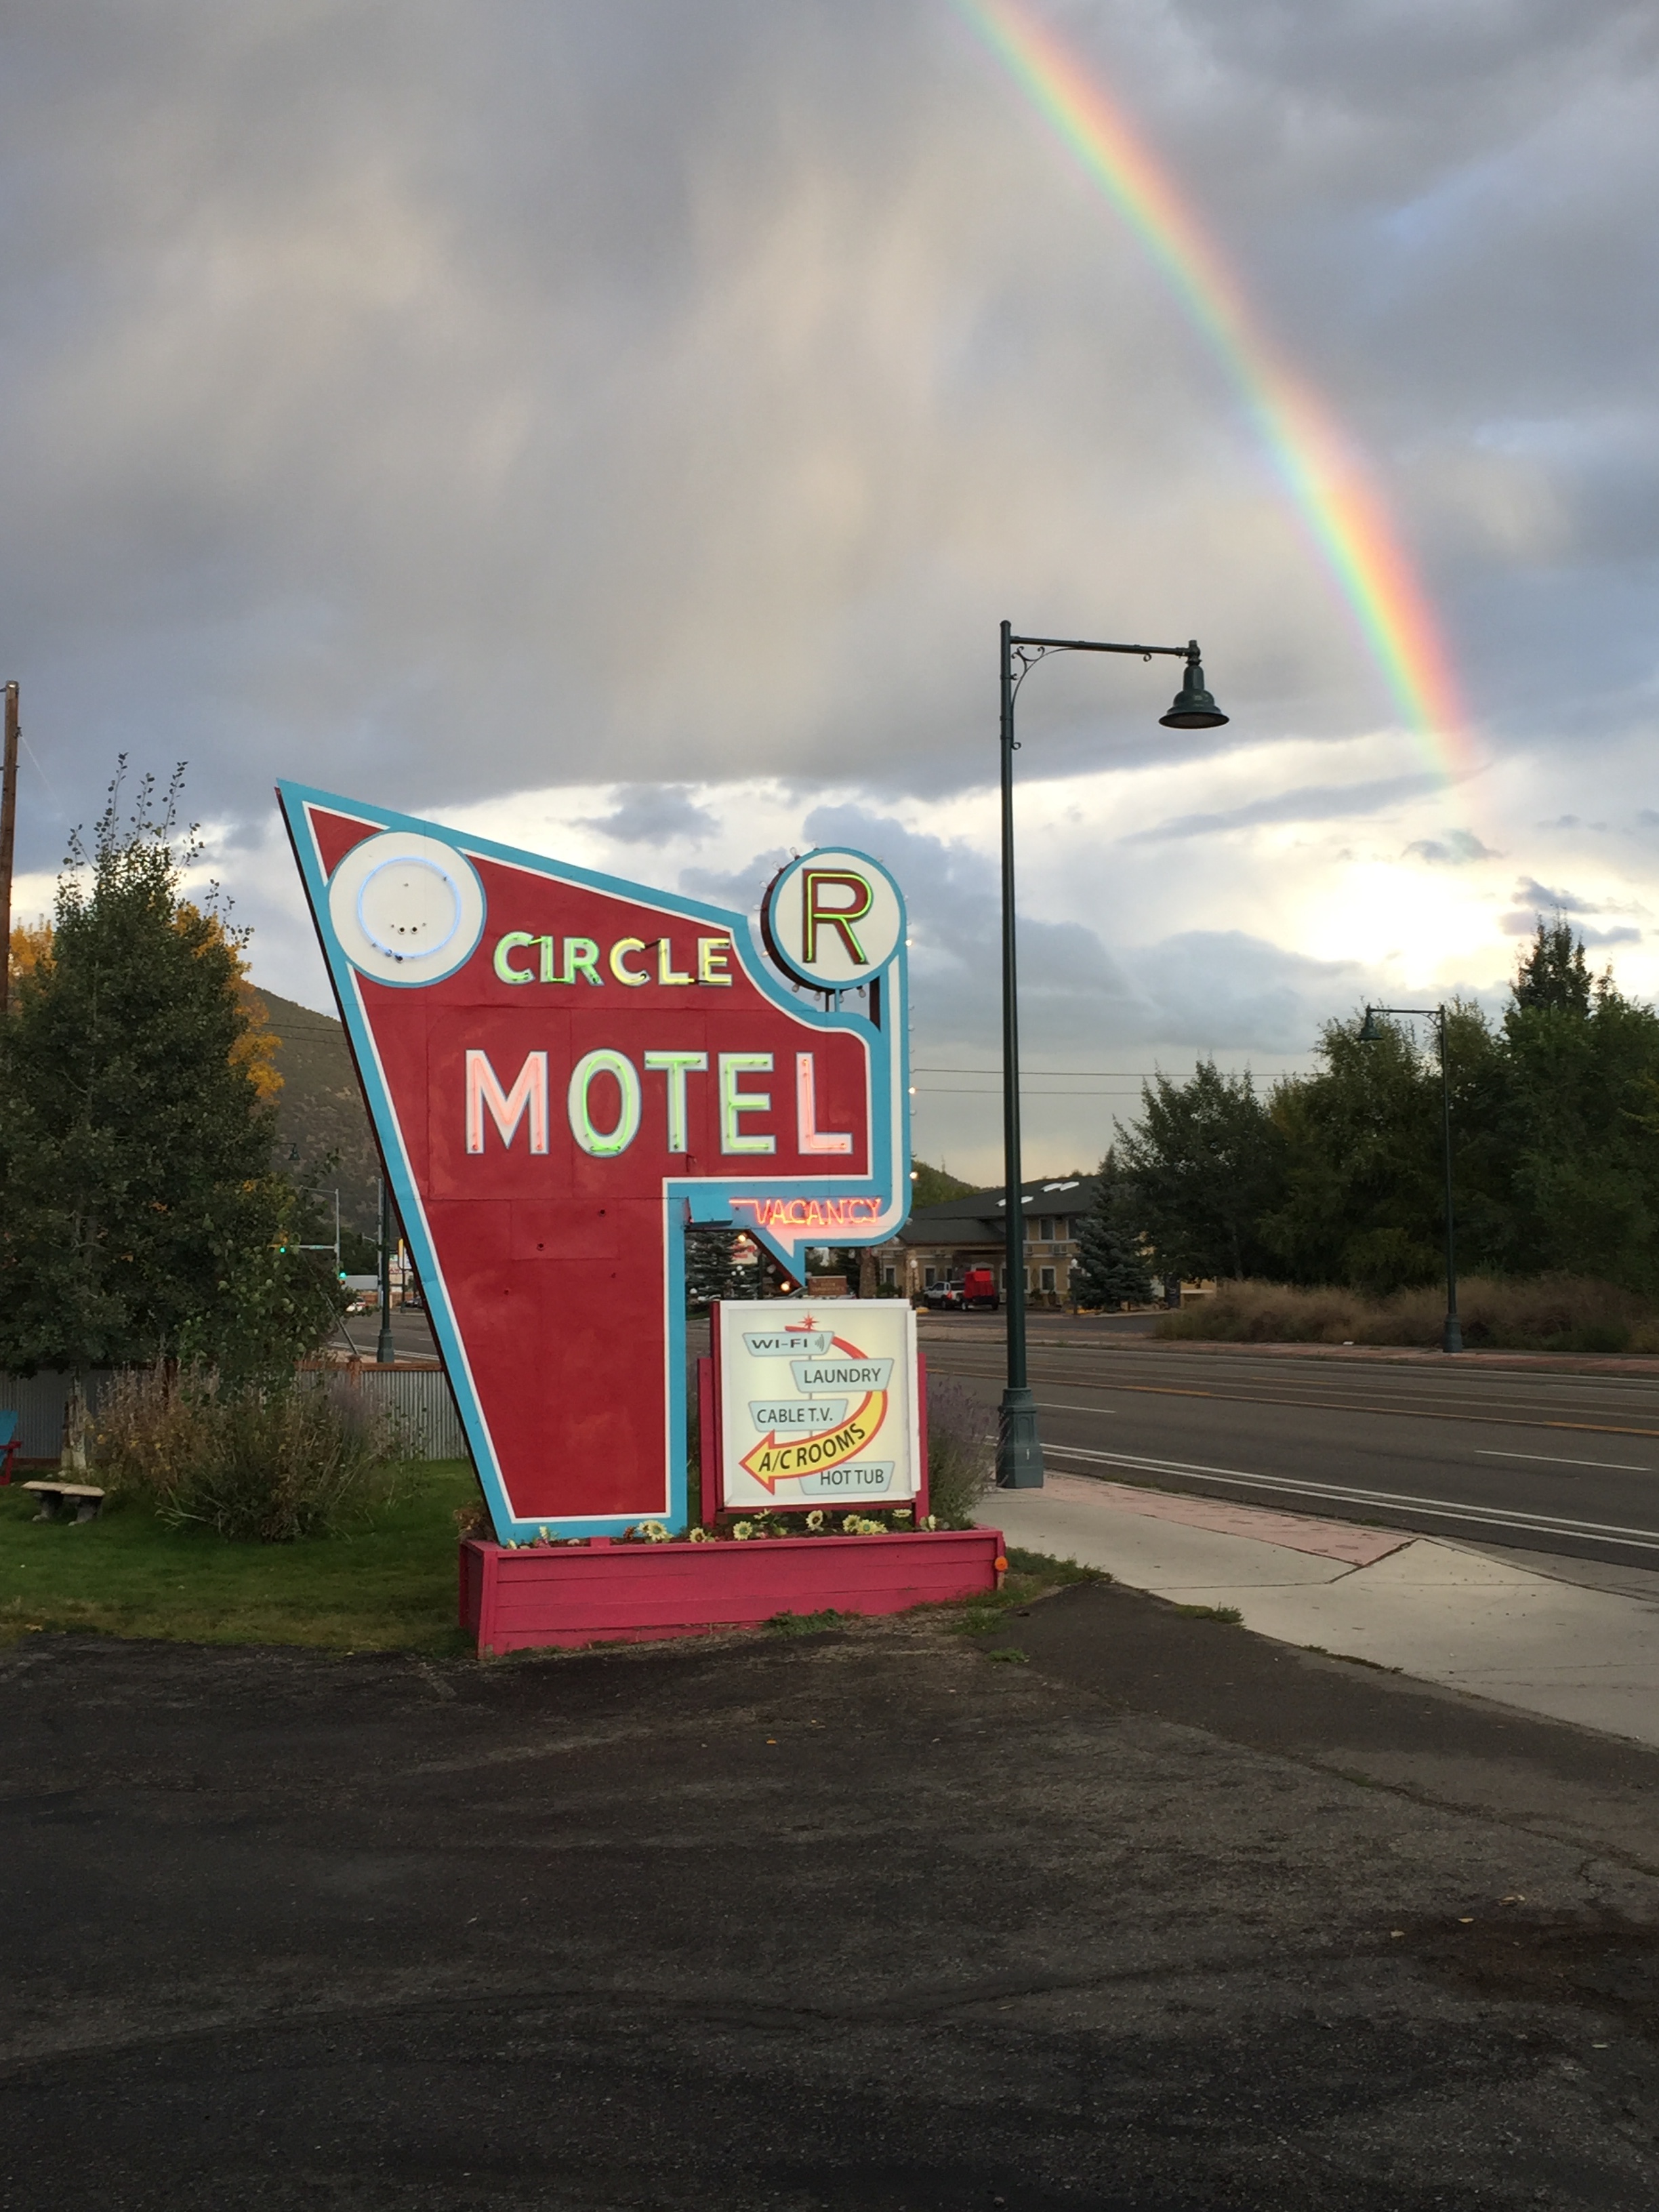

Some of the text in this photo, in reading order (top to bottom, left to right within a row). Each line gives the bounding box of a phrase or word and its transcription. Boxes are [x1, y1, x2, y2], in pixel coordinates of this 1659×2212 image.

[493, 868, 874, 986] CIRCLE R
[465, 1048, 853, 1158] MOTEL
[754, 1198, 881, 1225] VACANCY
[751, 1338, 808, 1349] WI-FI
[804, 1368, 881, 1384] LAUNDRY
[757, 1408, 833, 1423] CABLE T.V.
[758, 1423, 865, 1472] A/C ROOMS
[820, 1469, 884, 1486] HOT TUB
